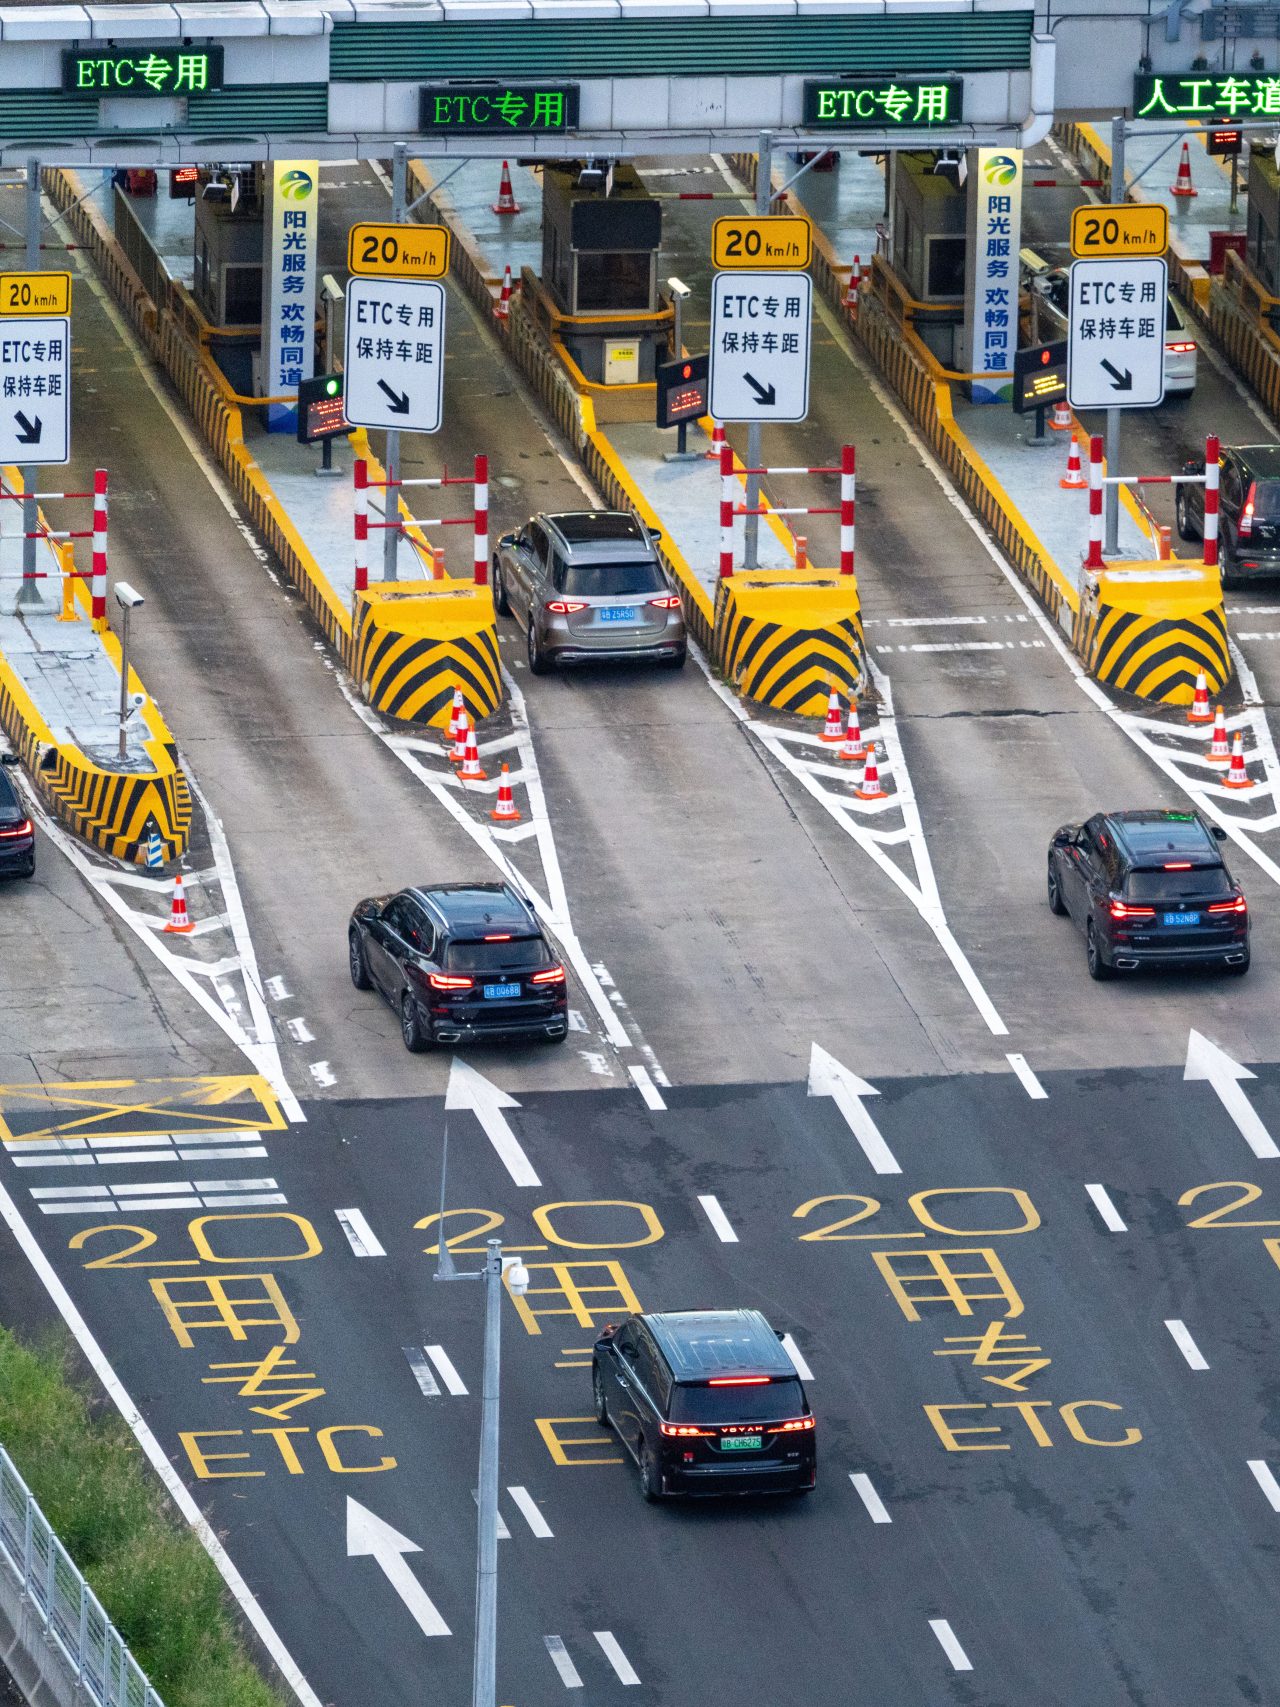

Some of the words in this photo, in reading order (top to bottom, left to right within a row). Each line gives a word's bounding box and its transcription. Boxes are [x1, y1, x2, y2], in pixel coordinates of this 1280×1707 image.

[76, 53, 208, 92] ETC专用
[433, 90, 564, 127] ETC专用
[817, 84, 949, 122] ETC专用
[725, 229, 762, 257] 20
[765, 242, 799, 256] km/h
[1083, 218, 1119, 246] 20
[1123, 231, 1156, 244] km/h
[361, 235, 399, 264] 20
[402, 251, 436, 265] km/h
[9, 283, 31, 307] 20
[34, 295, 57, 305] km/h
[722, 295, 801, 319] ETC专用
[1080, 281, 1156, 305] ETC专用
[356, 299, 434, 328] ETC专用
[721, 331, 799, 354] 保持车距
[1079, 316, 1156, 341] 保持车距
[2, 339, 62, 363] ETC专用
[356, 336, 433, 364] 保持车距
[2, 374, 62, 398] 保持车距
[412, 1200, 665, 1254] 20
[793, 1188, 1040, 1241] 20
[68, 1212, 324, 1269] 20
[925, 1401, 1140, 1451] ETC
[179, 1425, 397, 1479] ETC
